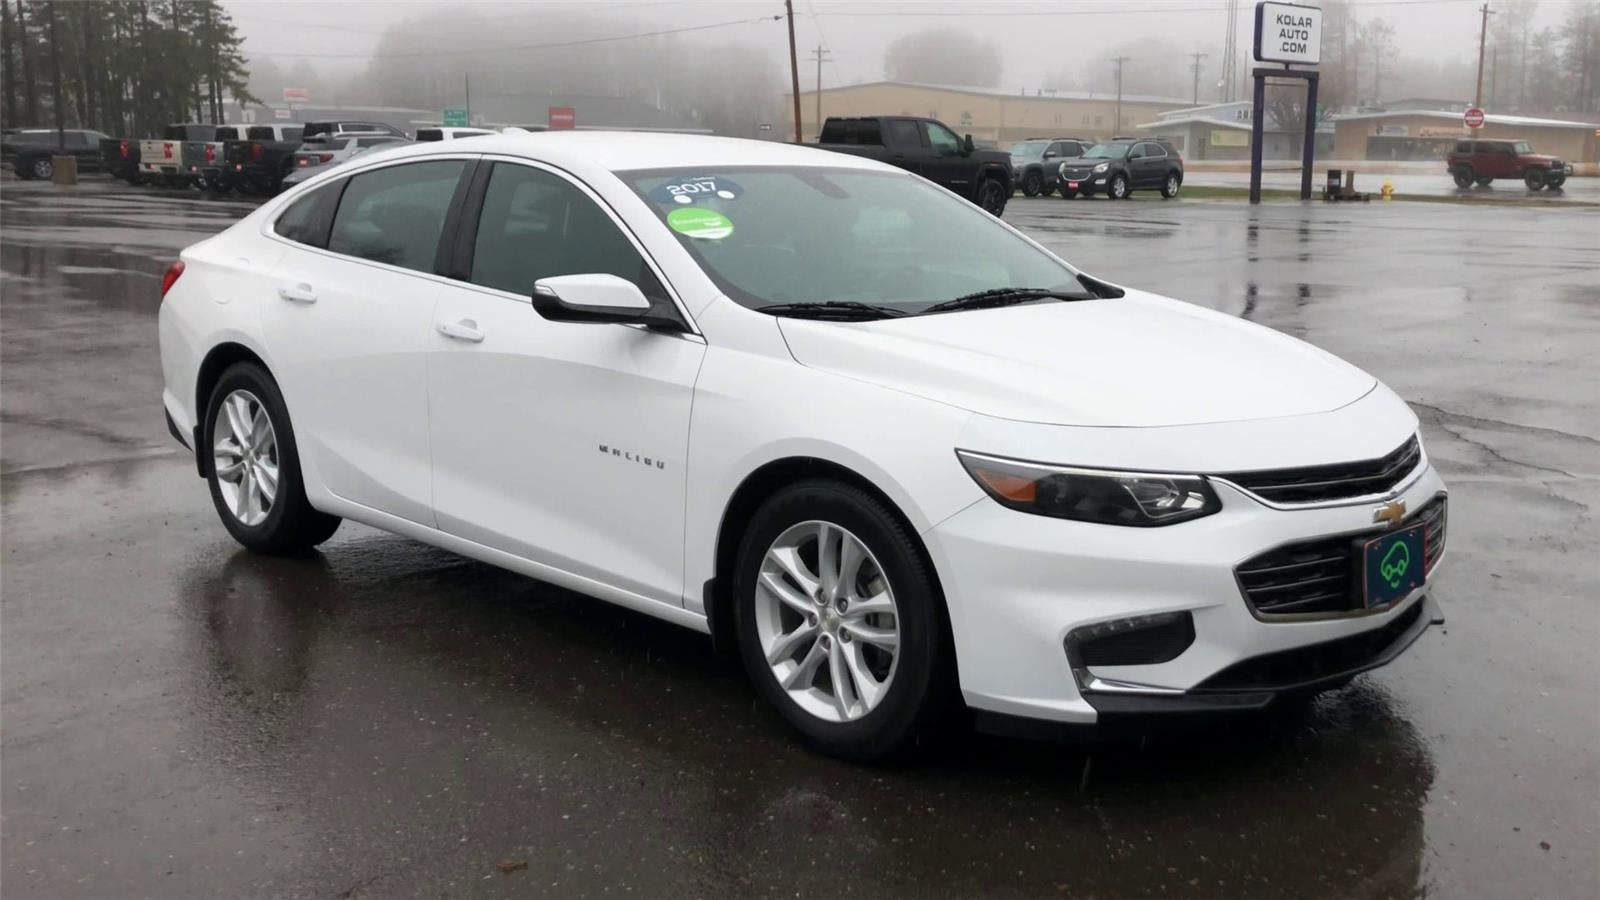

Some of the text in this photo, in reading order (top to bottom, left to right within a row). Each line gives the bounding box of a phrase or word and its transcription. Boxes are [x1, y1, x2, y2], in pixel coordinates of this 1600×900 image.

[1276, 14, 1313, 28] KOLAR
[1279, 28, 1308, 41] AUTO
[1279, 42, 1307, 54] .COM
[666, 181, 717, 195] 2017
[599, 445, 664, 469] MALIBU
